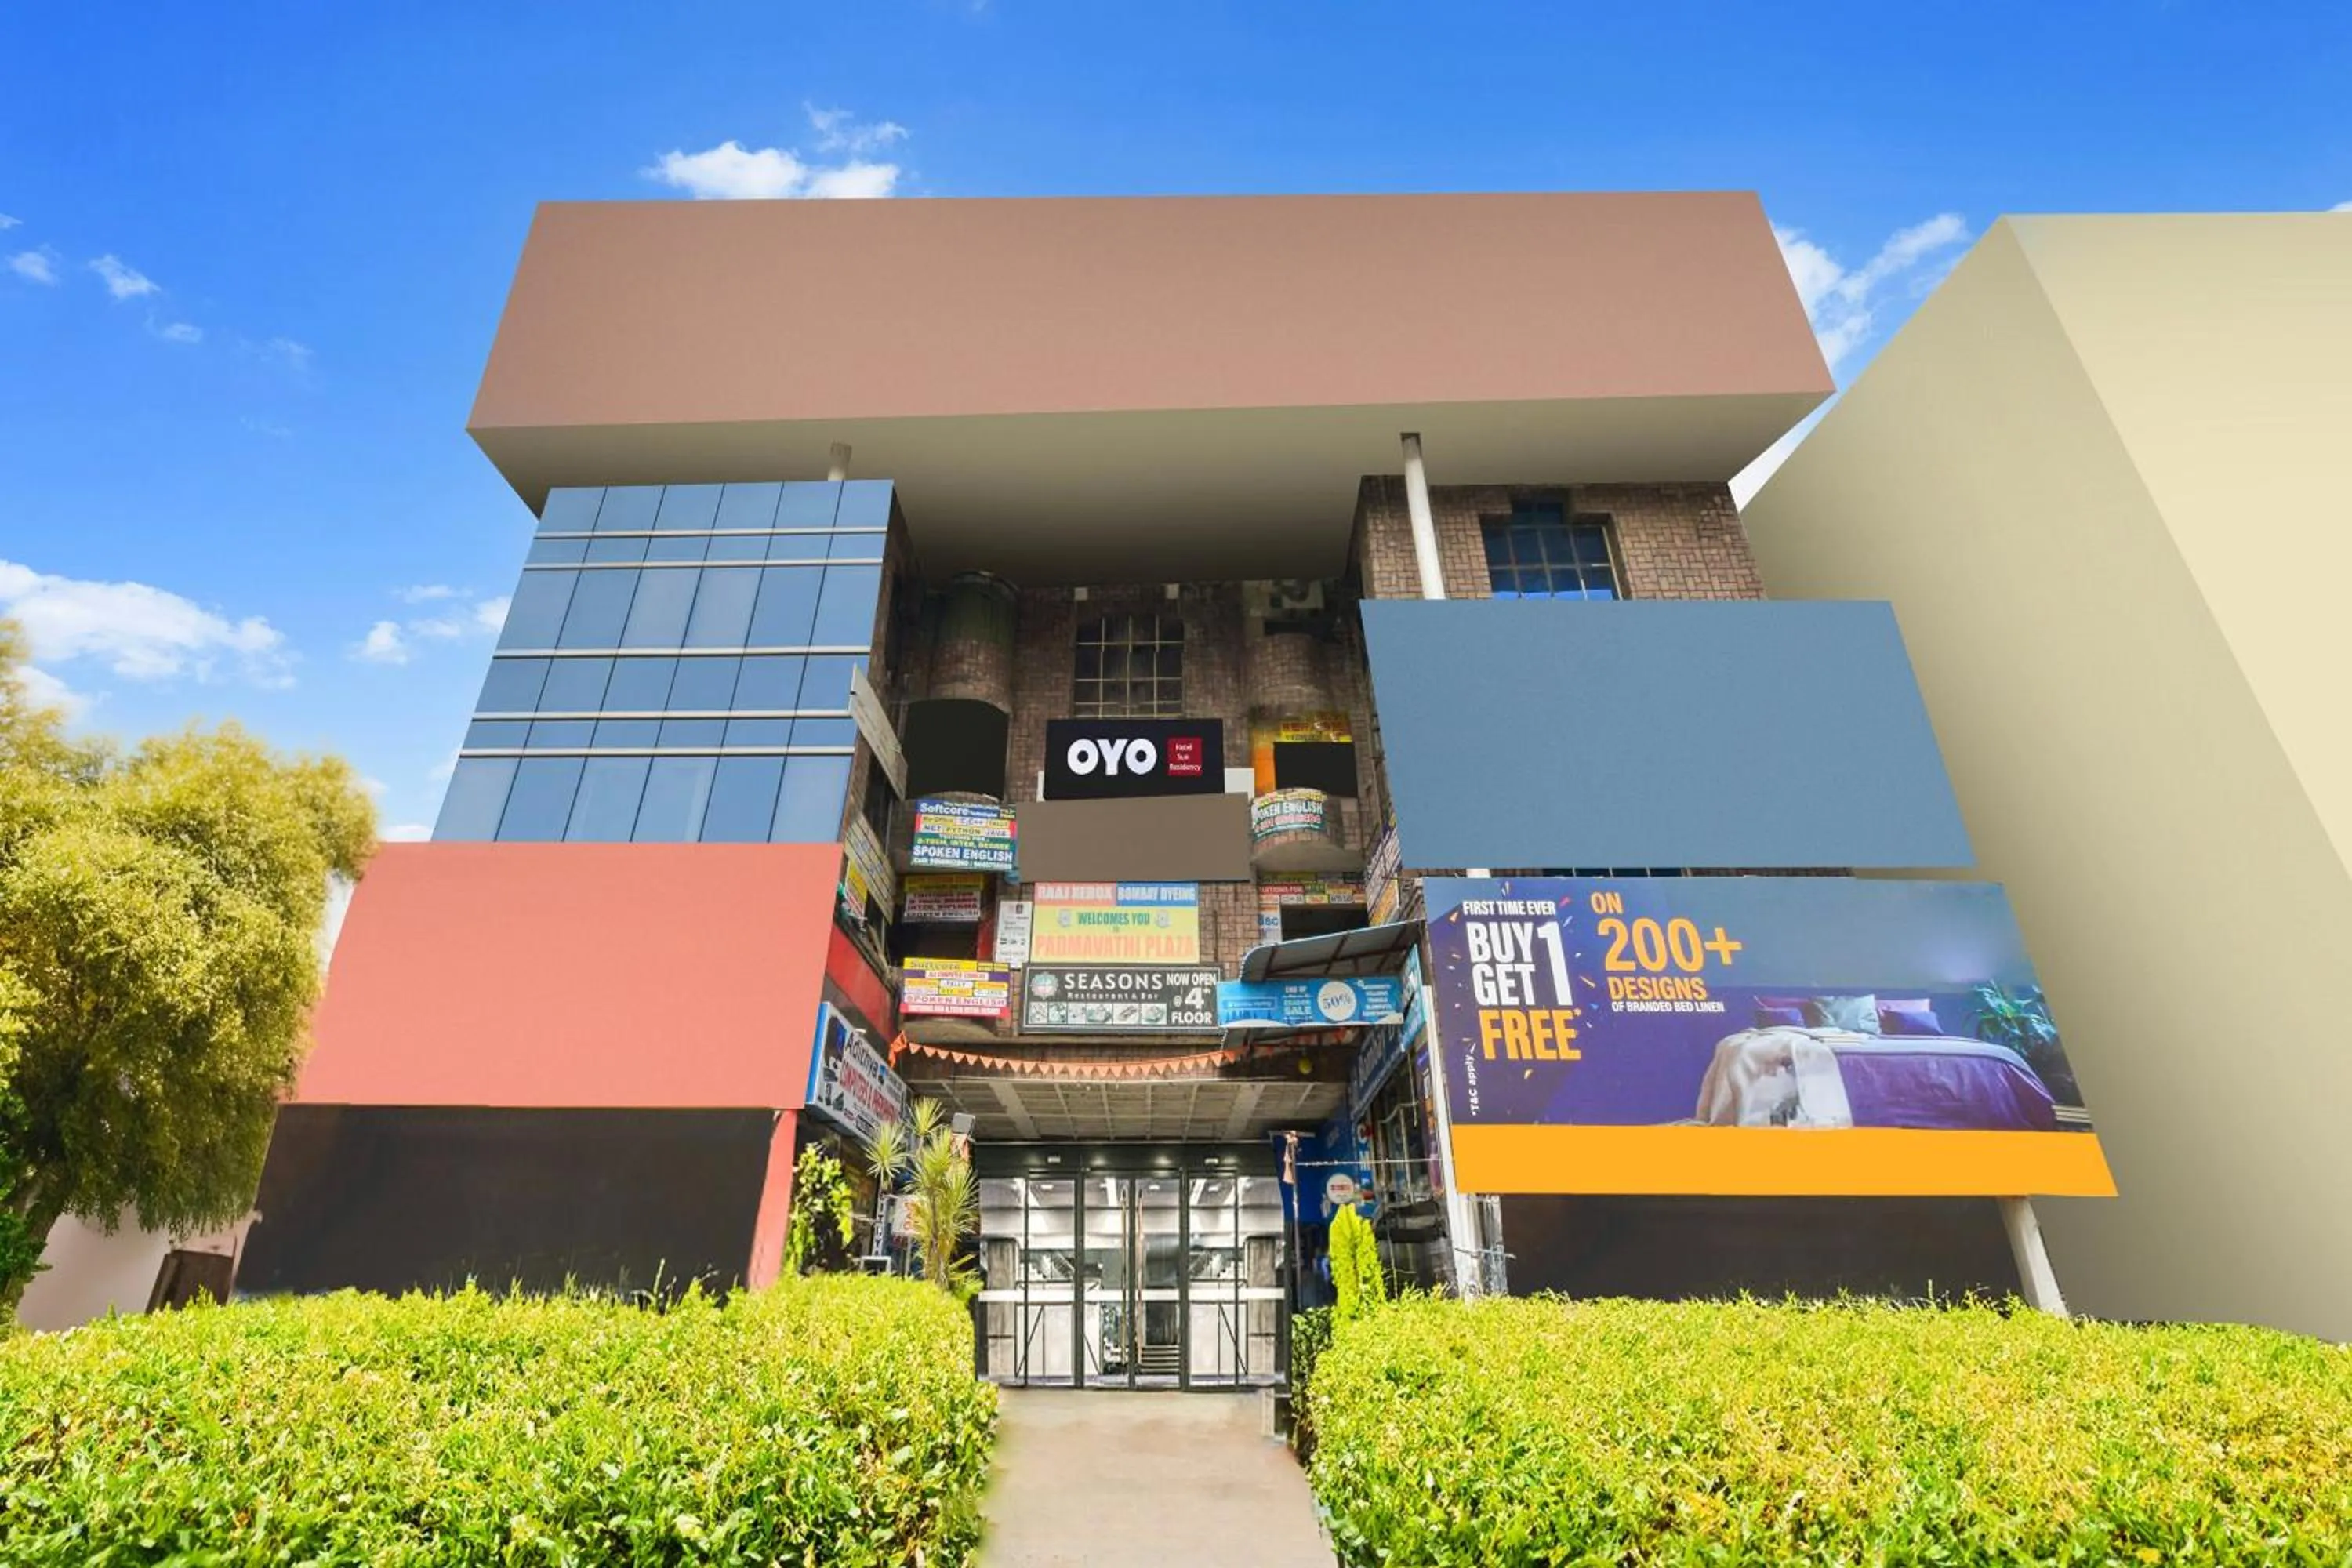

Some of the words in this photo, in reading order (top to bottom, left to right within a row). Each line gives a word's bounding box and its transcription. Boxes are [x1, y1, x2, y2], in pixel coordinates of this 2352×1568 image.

[1067, 738, 1157, 775] OYO
[1169, 763, 1201, 772] Residency
[920, 802, 969, 815] Softcore
[1283, 800, 1323, 815] ENGLISH
[913, 845, 960, 858] SPOKEN
[963, 848, 1013, 862] ENGLISH
[1039, 887, 1069, 900] RAAJ
[1073, 887, 1112, 900] XEROX
[1117, 887, 1157, 901] BOMBAY
[1160, 887, 1196, 901] DYEING
[1463, 901, 1495, 916] FIRST
[1496, 901, 1526, 916] TIME
[1527, 901, 1556, 916] EVER
[1591, 891, 1624, 914] ON
[1078, 912, 1130, 926] WELCOMES
[1132, 912, 1150, 925] YOU
[1036, 935, 1138, 958] PADMAVATHI
[1145, 935, 1194, 958] PLAZA
[1597, 917, 1742, 972] 200+
[1466, 921, 1534, 963] BUY
[1537, 920, 1573, 1006] 1
[1065, 973, 1163, 989] SEASONS
[1166, 973, 1190, 985] NOW
[1191, 974, 1216, 985] OPEN
[1472, 964, 1535, 1006] GET
[1607, 976, 1708, 1000] DESIGNS
[906, 994, 953, 1004] SPOKEN
[956, 996, 1006, 1006] ENGLISH
[1611, 1001, 1624, 1012] OF
[1627, 1001, 1672, 1012] BRANDED
[1674, 1001, 1694, 1012] BED
[1696, 1001, 1725, 1012] LINEN
[1171, 1011, 1213, 1025] FLOOR
[1465, 1054, 1477, 1086] apply
